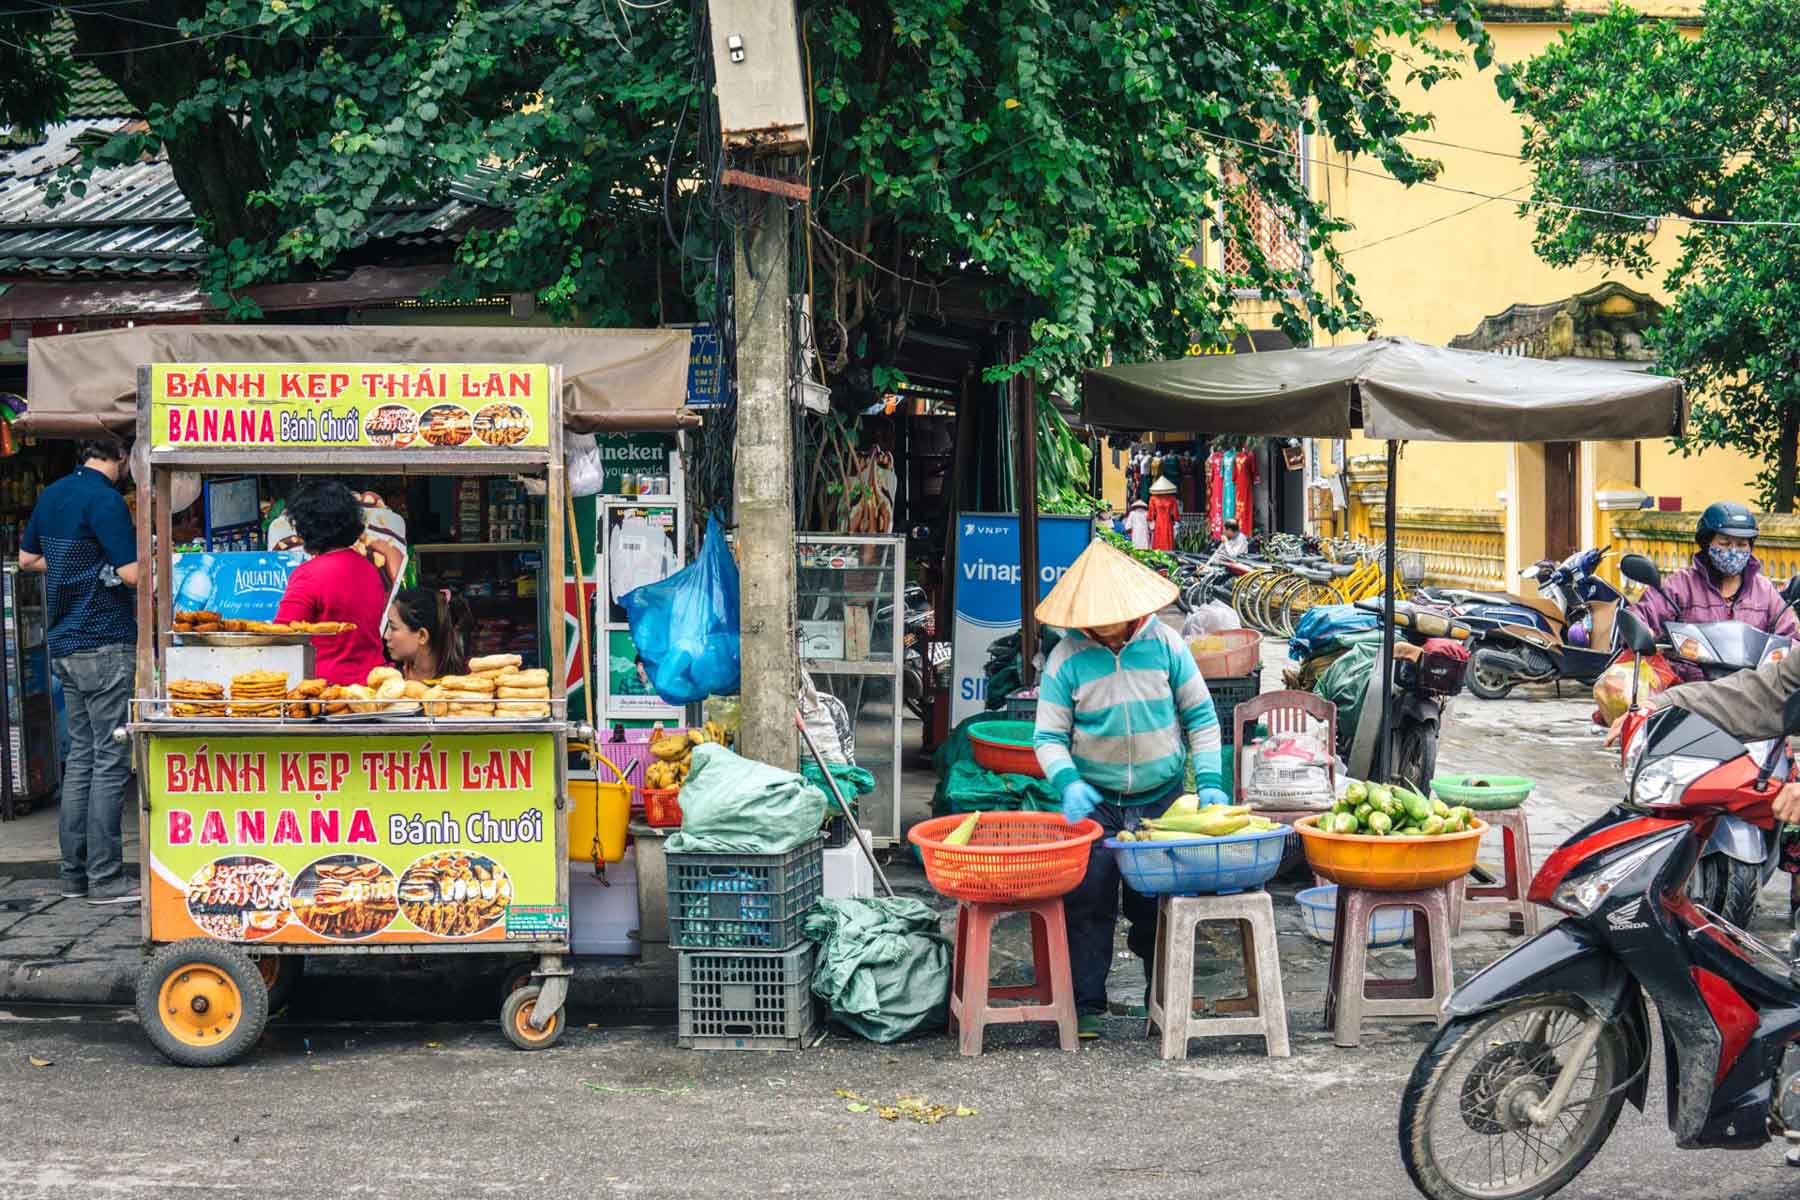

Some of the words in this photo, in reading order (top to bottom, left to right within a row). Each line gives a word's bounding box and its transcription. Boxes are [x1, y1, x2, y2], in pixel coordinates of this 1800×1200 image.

[166, 367, 265, 398] BÁNH
[280, 373, 350, 404] KẸP
[362, 367, 448, 398] THÁI
[462, 373, 531, 397] LAN
[169, 409, 274, 442] BANANA
[280, 410, 316, 442] Bánh
[319, 405, 359, 442] Chuối
[600, 443, 664, 460] ineken
[977, 527, 1011, 535] VNPT
[233, 568, 289, 592] AQUAFINA
[166, 743, 266, 793] BÁNH
[280, 751, 350, 801] KẸP
[362, 742, 448, 793] THÁI
[460, 750, 533, 790] LAN
[168, 809, 378, 845] BANANA
[389, 810, 459, 844] Bánh
[466, 808, 543, 843] Chuối
[1609, 921, 1649, 931] HONDA
